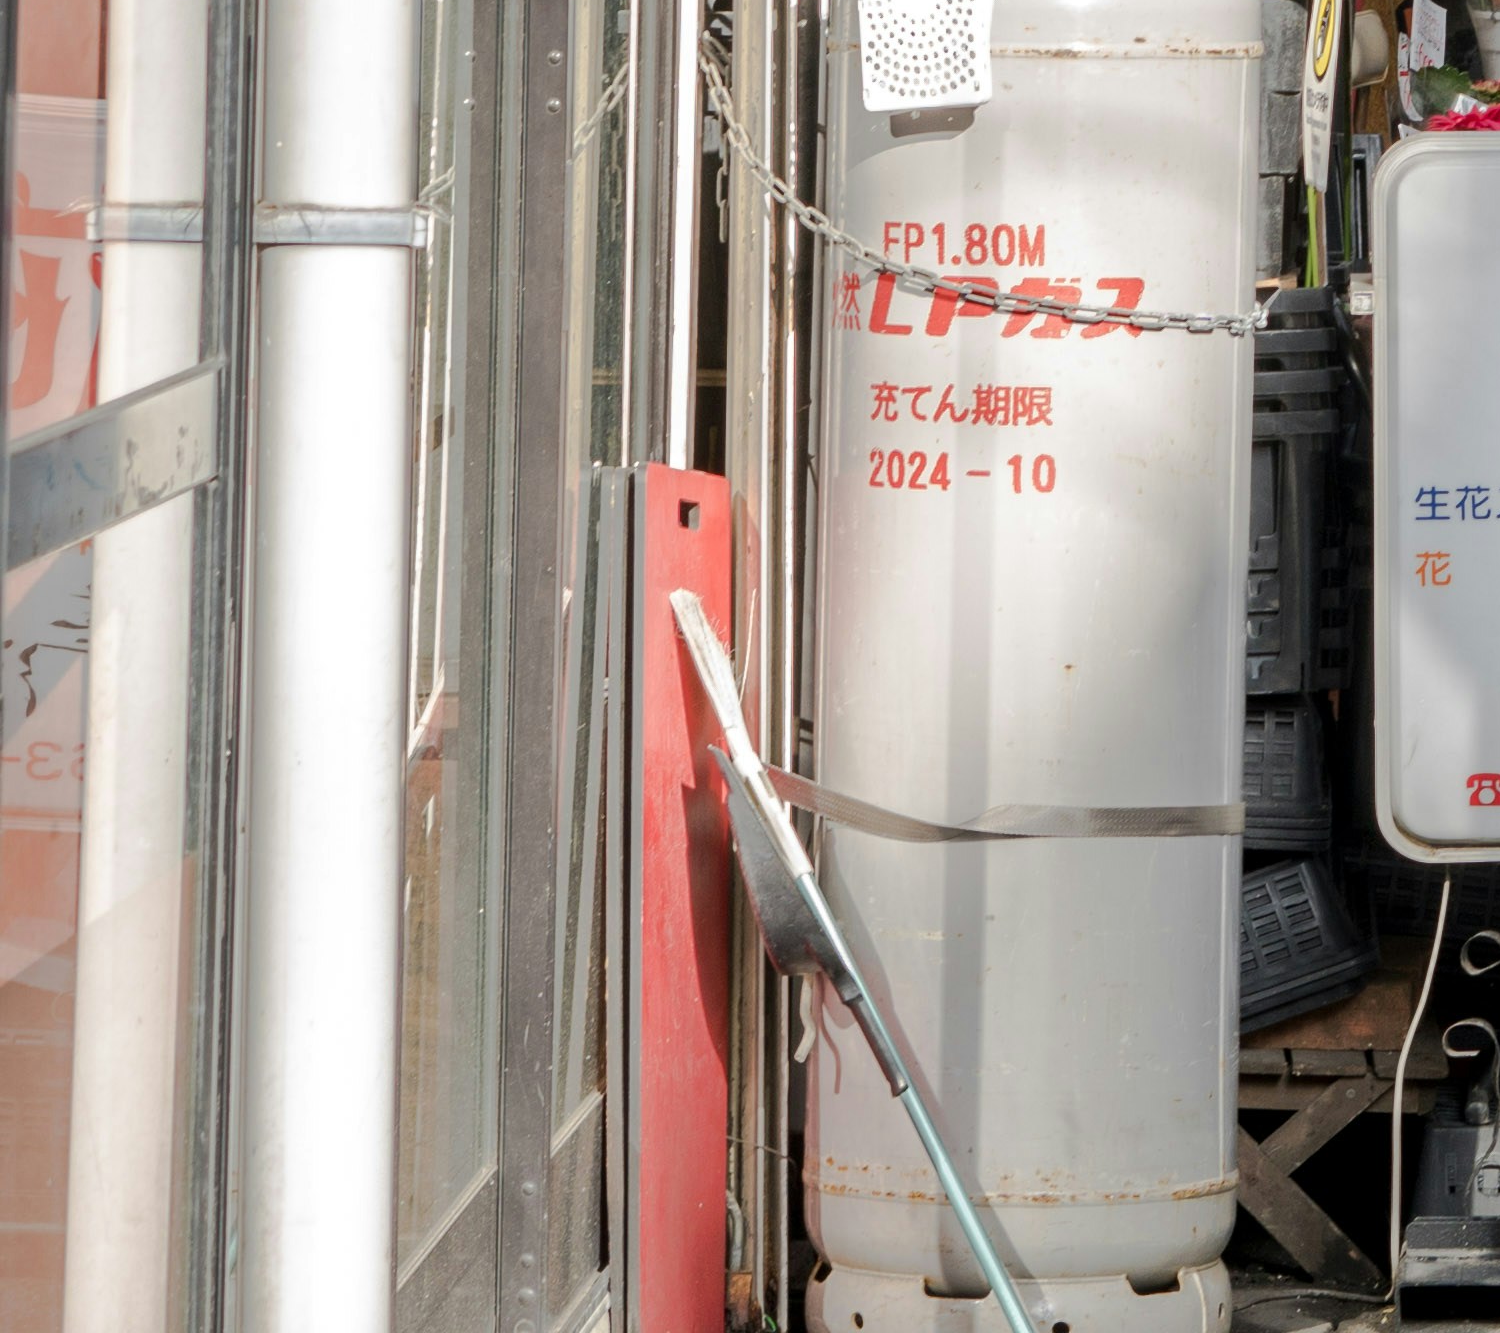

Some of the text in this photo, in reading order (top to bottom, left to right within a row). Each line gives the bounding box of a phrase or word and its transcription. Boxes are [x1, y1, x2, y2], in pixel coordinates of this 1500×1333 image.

[869, 383, 1054, 427] 充てん期限
